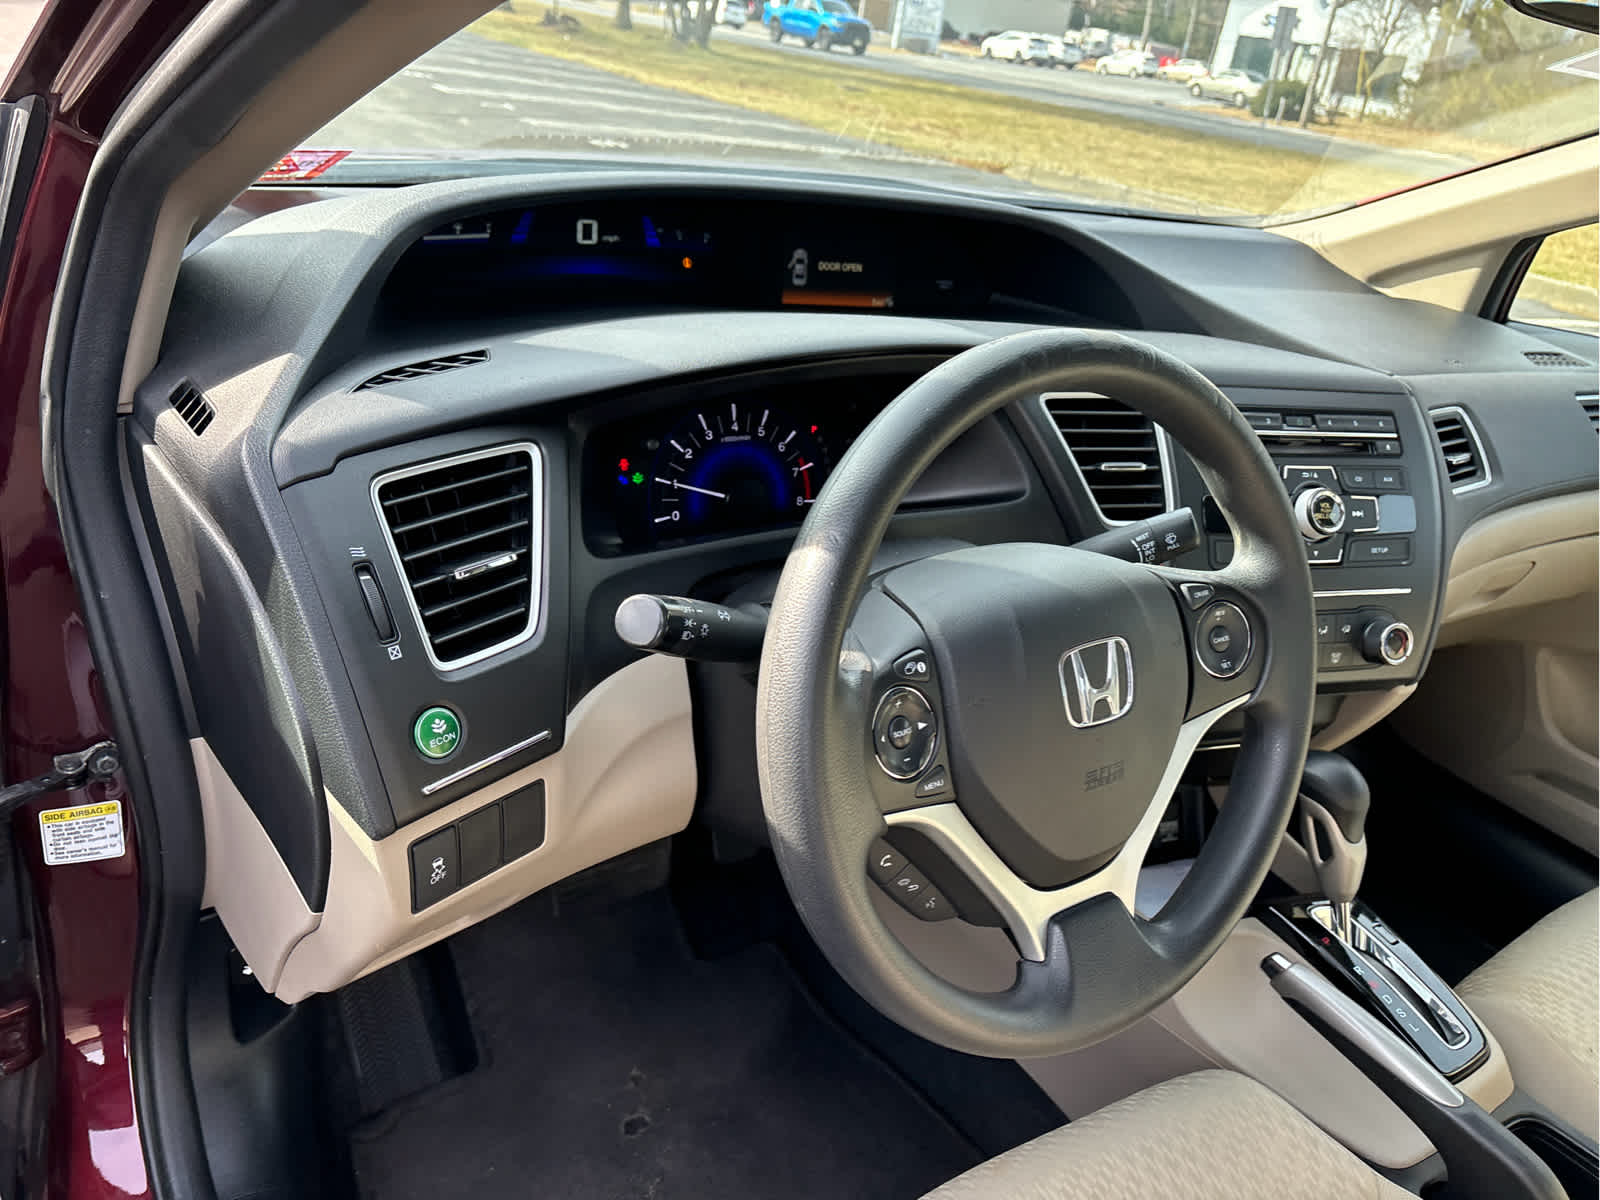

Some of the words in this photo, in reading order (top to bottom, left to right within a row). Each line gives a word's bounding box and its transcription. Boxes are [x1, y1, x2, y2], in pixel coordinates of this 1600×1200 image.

[576, 219, 598, 245] 0
[818, 261, 840, 272] DOOR
[842, 262, 863, 273] OPEN
[731, 422, 739, 432] 4
[758, 426, 766, 437] 5
[705, 430, 713, 441] 3
[778, 442, 786, 452] 6
[684, 448, 693, 459] 2
[671, 511, 680, 521] 0
[1141, 540, 1156, 550] OFF
[429, 731, 456, 749] ECON
[924, 779, 945, 792] MENU
[44, 812, 66, 822] SIDE
[69, 806, 104, 818] AIRBAG
[430, 871, 447, 885] OFF
